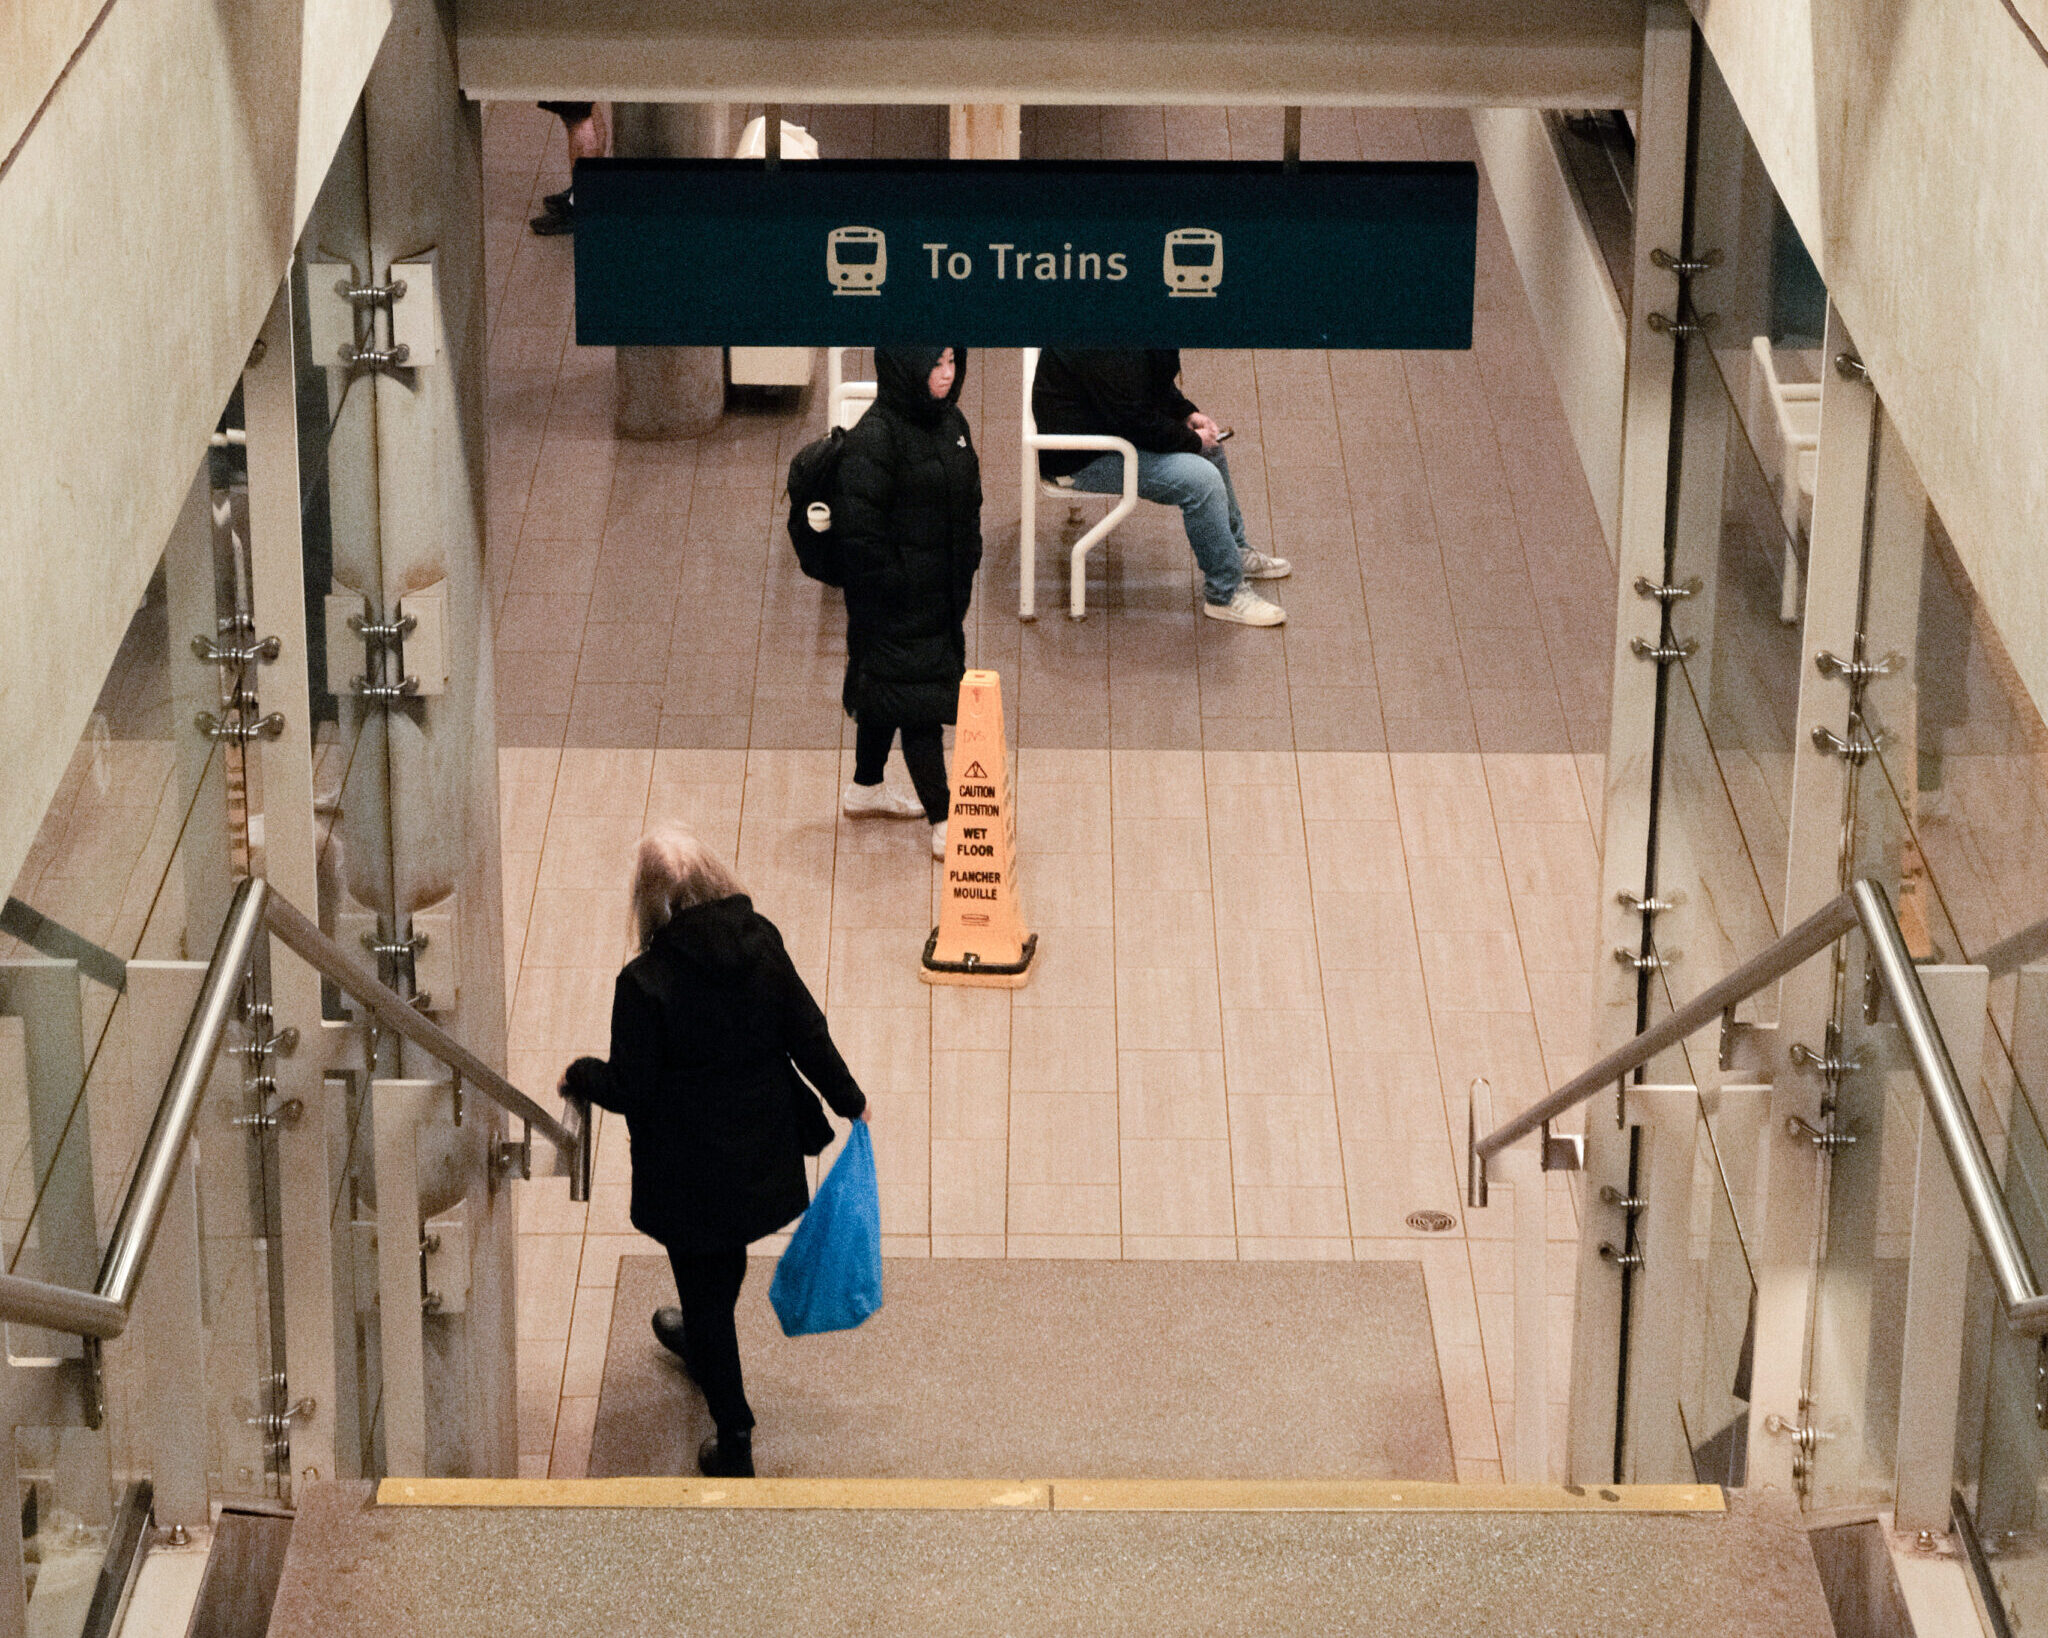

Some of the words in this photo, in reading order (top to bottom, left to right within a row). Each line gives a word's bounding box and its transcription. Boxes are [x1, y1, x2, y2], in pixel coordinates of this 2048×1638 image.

[922, 243, 972, 280] To
[988, 242, 1128, 281] Trains
[959, 785, 996, 798] CAUTION
[954, 803, 1000, 817] ATTENTION
[963, 827, 988, 840] WET
[957, 844, 994, 857] FLOOR
[950, 870, 1001, 884] PLANCHER
